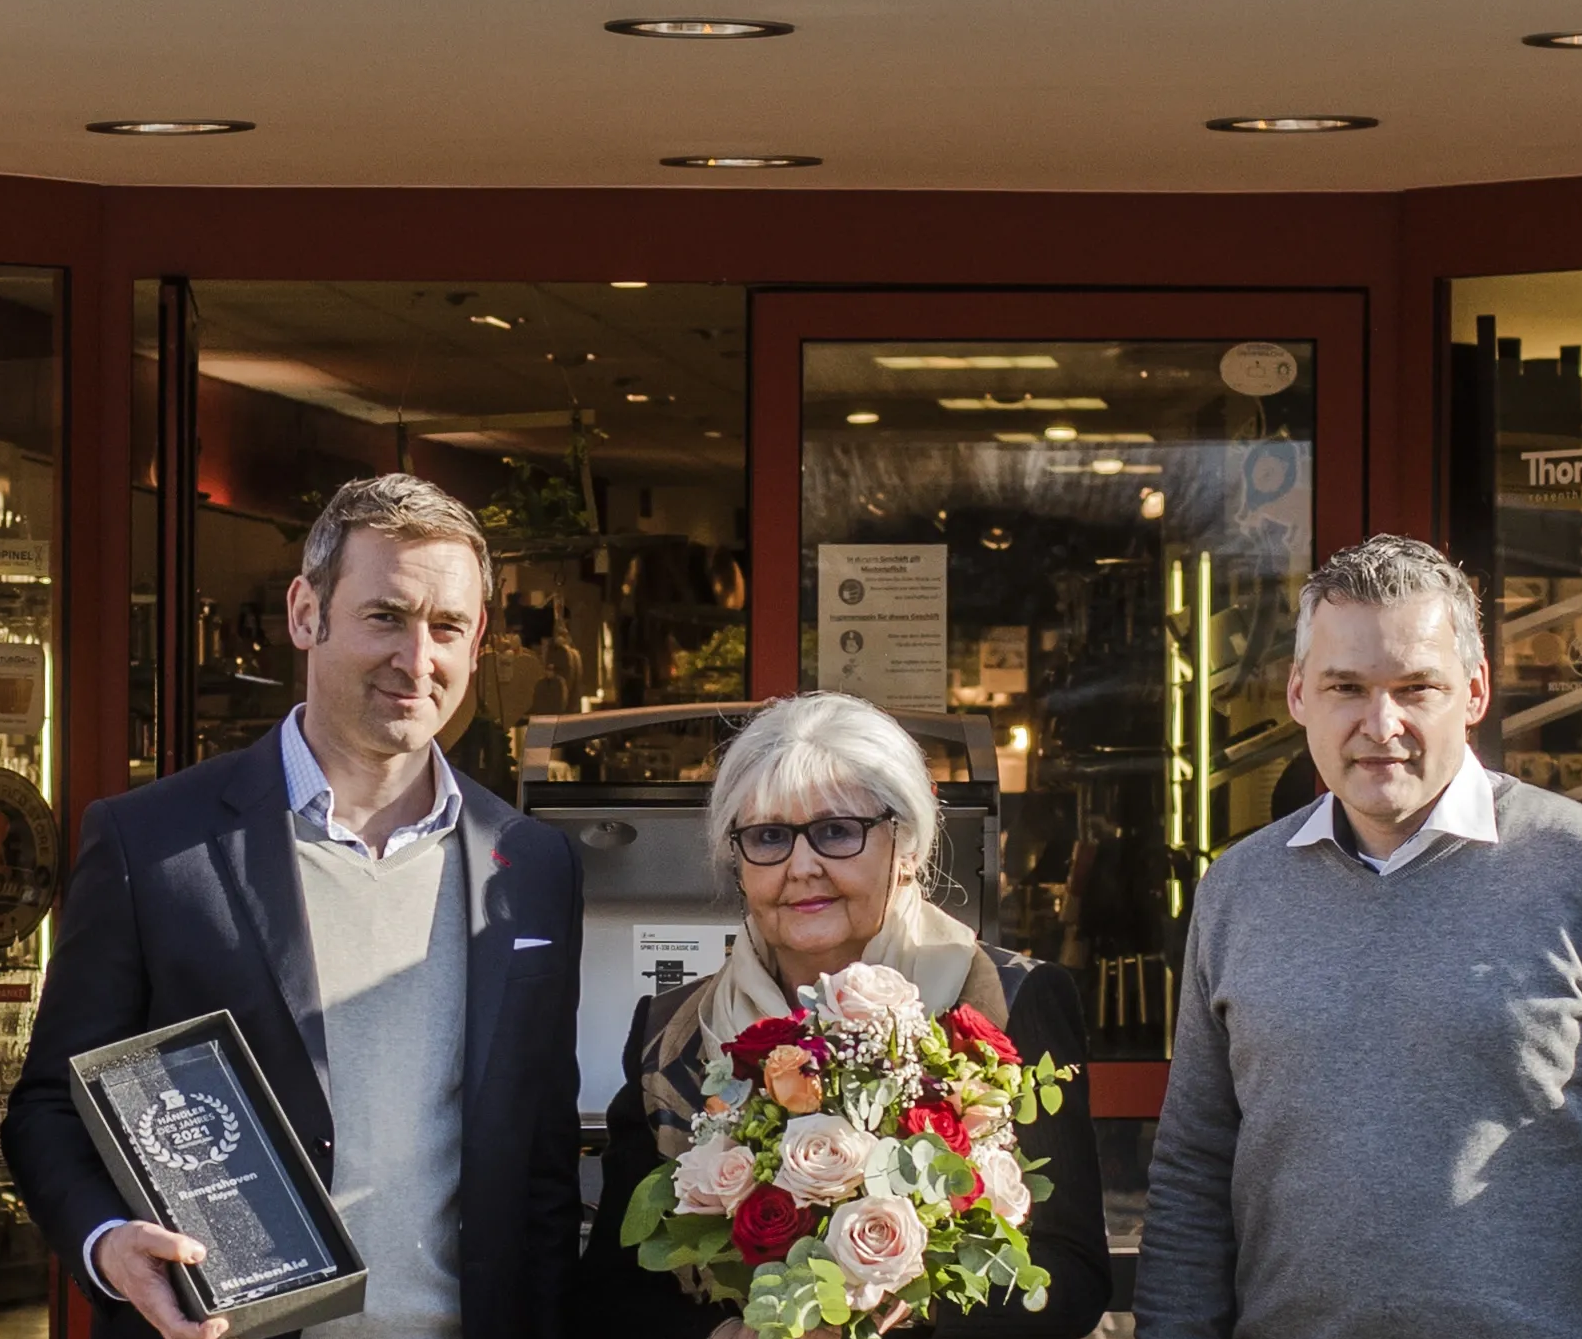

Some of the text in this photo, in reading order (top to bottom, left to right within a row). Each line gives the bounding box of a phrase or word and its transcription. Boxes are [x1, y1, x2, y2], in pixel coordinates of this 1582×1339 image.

[157, 1112, 216, 1136] DES JAHRES
[159, 1106, 206, 1126] HÄNDLER
[172, 1125, 211, 1145] 2021
[178, 1172, 258, 1201] Ramershoven
[207, 1188, 239, 1203] Mayen
[220, 1258, 309, 1292] KitchenAid
